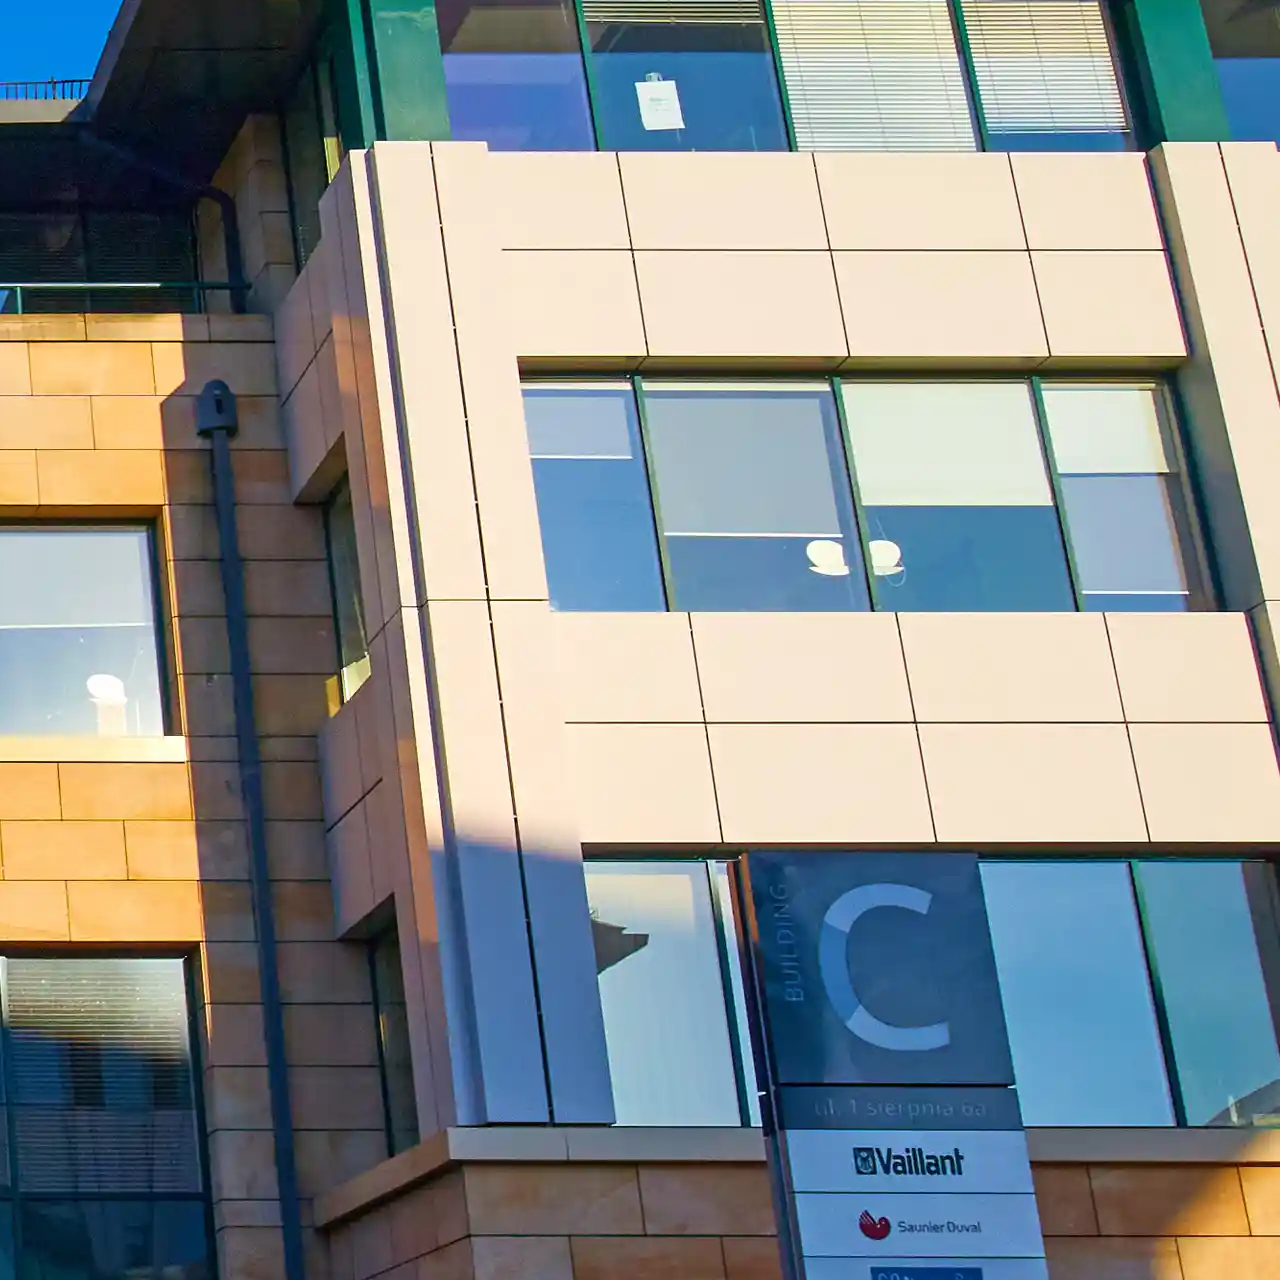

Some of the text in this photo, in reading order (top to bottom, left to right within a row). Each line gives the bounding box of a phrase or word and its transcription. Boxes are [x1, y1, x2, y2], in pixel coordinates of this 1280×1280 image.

[769, 883, 805, 1002] BUILDING
[818, 882, 950, 1051] C
[875, 1147, 965, 1176] Vaillant
